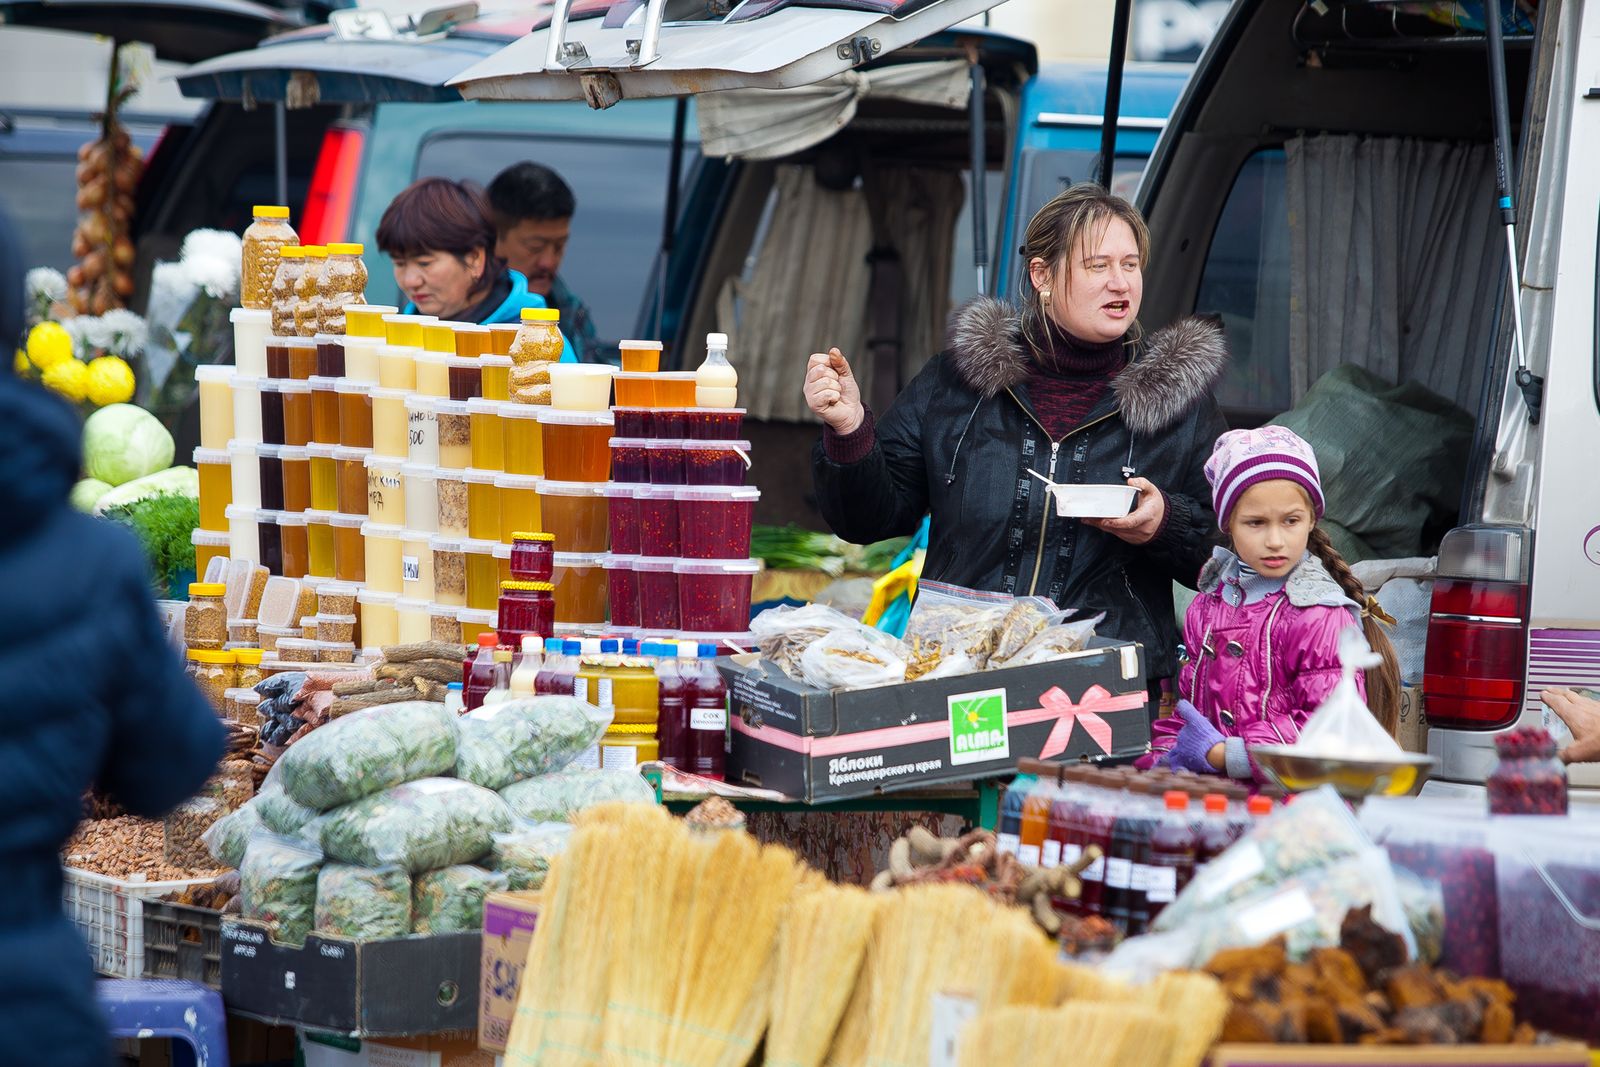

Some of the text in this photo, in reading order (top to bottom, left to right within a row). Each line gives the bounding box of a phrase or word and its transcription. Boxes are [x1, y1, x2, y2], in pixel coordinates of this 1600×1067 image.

[955, 728, 1006, 752] ALMA
[828, 755, 884, 775] Яблоки
[828, 759, 942, 787] Краснодарского края
